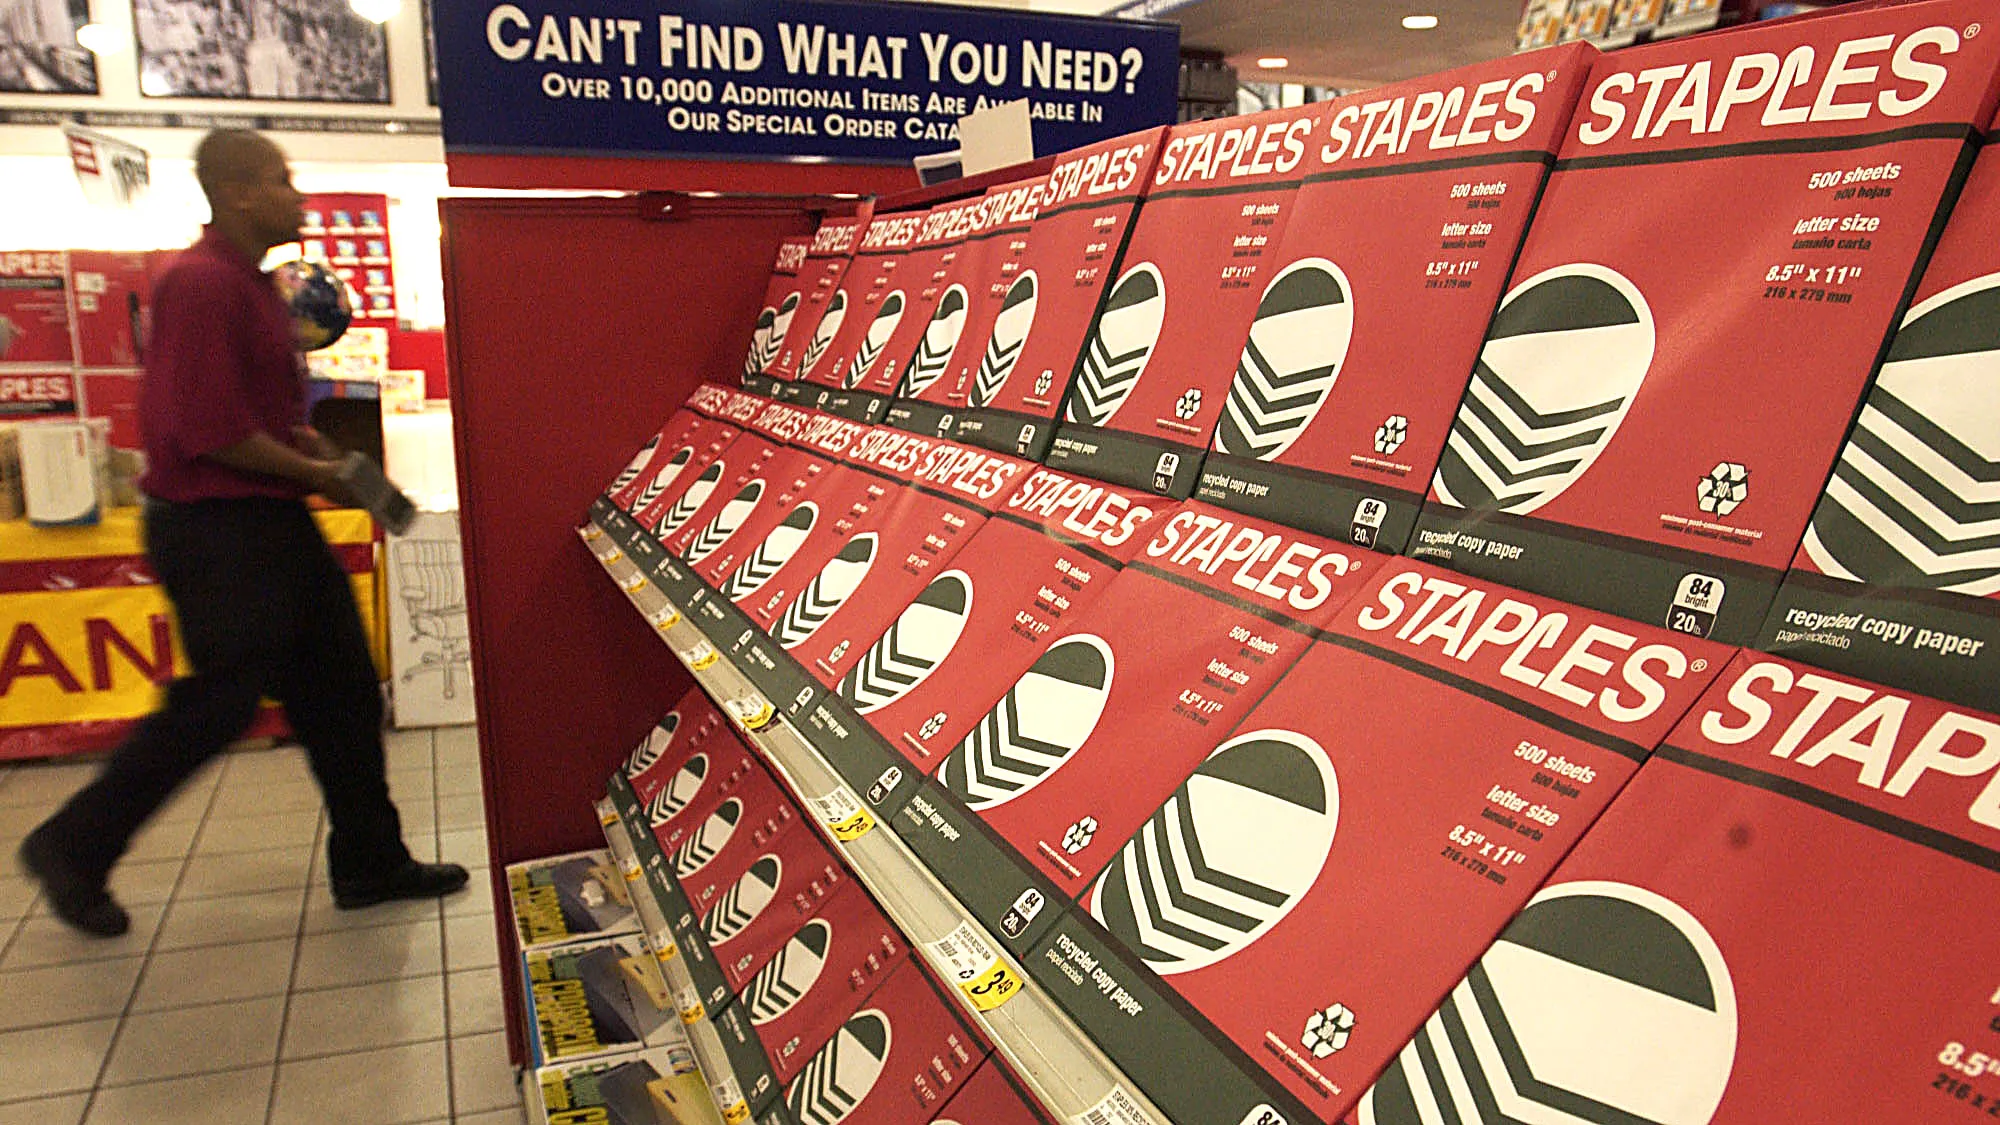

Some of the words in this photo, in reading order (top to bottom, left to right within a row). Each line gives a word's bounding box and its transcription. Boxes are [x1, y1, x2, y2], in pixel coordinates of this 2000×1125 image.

[486, 4, 642, 66] CAN'T
[659, 14, 764, 73] FIND
[777, 22, 908, 80] WHAT
[920, 32, 1008, 86] YOU
[1022, 39, 1144, 94] NEED?
[541, 72, 610, 99] OVER
[620, 76, 712, 105] 10,000
[720, 81, 855, 109] ADDITIONAL
[862, 87, 920, 113] ITEMS
[925, 91, 966, 115] ARE
[972, 94, 1076, 121] AABLE
[1081, 100, 1103, 123] IN
[1578, 26, 1960, 145] STAPLES
[667, 106, 720, 132] OUR
[726, 109, 817, 136] SPECIAL
[823, 113, 897, 138] ORDER
[904, 117, 961, 142] CATA
[1321, 72, 1545, 164] STAPLES
[1155, 117, 1312, 186] STAPLES
[1043, 144, 1144, 206] STAPLES
[1450, 183, 1471, 199] 500
[1470, 181, 1507, 197] sheets
[1808, 170, 1842, 190] 500
[1842, 162, 1902, 184] sheets
[860, 217, 921, 248] STAPLES
[1440, 222, 1470, 237] letter
[1469, 220, 1493, 236] size
[1792, 214, 1839, 236] letter
[1839, 212, 1881, 232] size
[776, 243, 807, 269] STAP
[1765, 263, 1806, 282] 8.5"
[1804, 268, 1821, 283] x
[1825, 266, 1862, 285] 11"
[753, 404, 808, 440] STAPLES
[797, 415, 860, 453] STAPLES
[849, 428, 930, 472] STAPLES
[914, 444, 1017, 499] STAPLES
[1229, 479, 1248, 494] copy
[1246, 482, 1270, 498] paper
[1008, 469, 1154, 547] STAPLES
[1363, 501, 1379, 515] 84
[1354, 527, 1367, 542] 20
[1457, 534, 1488, 556] copy
[1485, 541, 1524, 561] paper
[1147, 509, 1349, 612] STAPLES
[1684, 593, 1709, 609] bright
[1689, 577, 1713, 598] 84
[1228, 625, 1251, 643] 500
[1247, 636, 1279, 655] sheets
[1673, 612, 1696, 632] 20
[1785, 607, 1865, 631] recycled
[1861, 617, 1914, 644] copy
[1913, 625, 1984, 658] paper
[1357, 571, 1688, 723] STAPLES
[1207, 657, 1234, 679] letter
[1513, 740, 1548, 765] 500
[1543, 755, 1597, 784] sheets
[1701, 662, 2000, 832] STAP
[1485, 784, 1530, 813] letter
[1525, 804, 1560, 827] size
[1448, 824, 1486, 847] 8.5"
[1478, 842, 1495, 857] x
[1492, 845, 1527, 866] 11"
[1025, 892, 1040, 908] 84
[1003, 912, 1019, 930] 20
[1056, 933, 1099, 974] recycled
[1091, 967, 1118, 994] copy
[1109, 986, 1143, 1017] paper
